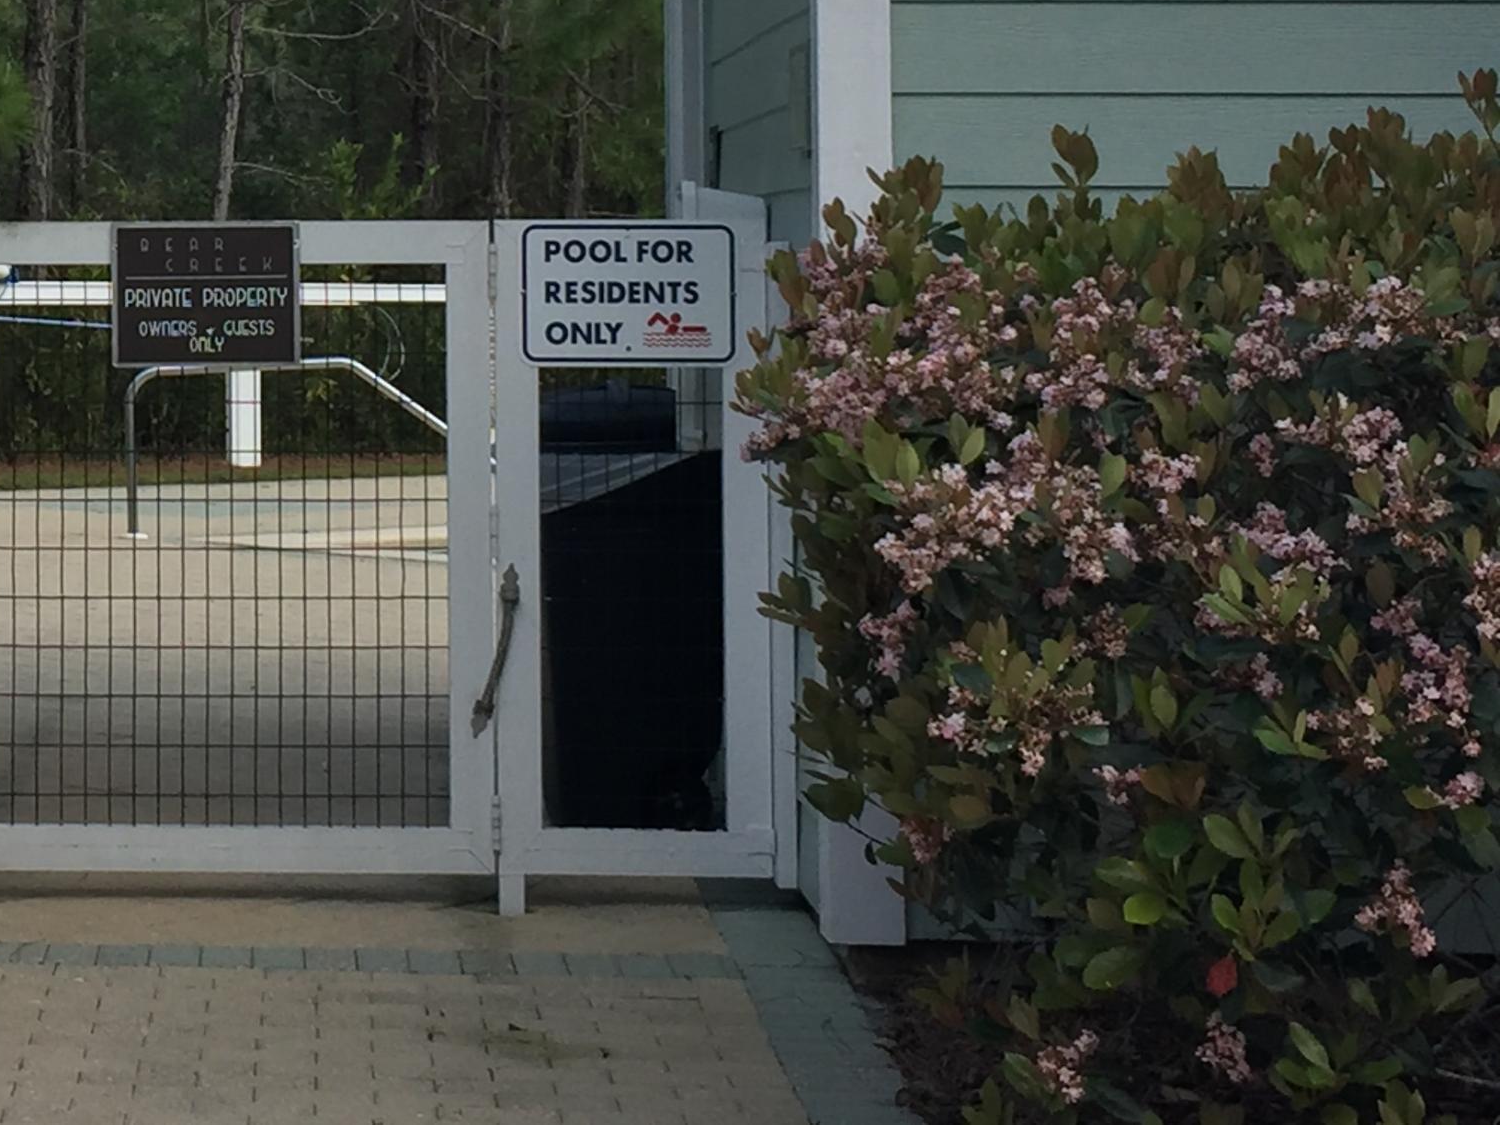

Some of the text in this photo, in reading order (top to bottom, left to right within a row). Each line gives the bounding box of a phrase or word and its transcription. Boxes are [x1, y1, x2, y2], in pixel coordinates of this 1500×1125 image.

[544, 239, 694, 263] POOL FOR
[165, 257, 272, 272] CREEK
[124, 286, 288, 308] PRIVATE PROPERTY
[544, 280, 699, 305] RESIDENTS
[138, 320, 197, 337] OWNERS
[223, 319, 275, 337] GUESTS
[545, 321, 624, 346] ONLY
[189, 336, 225, 353] ONLY
